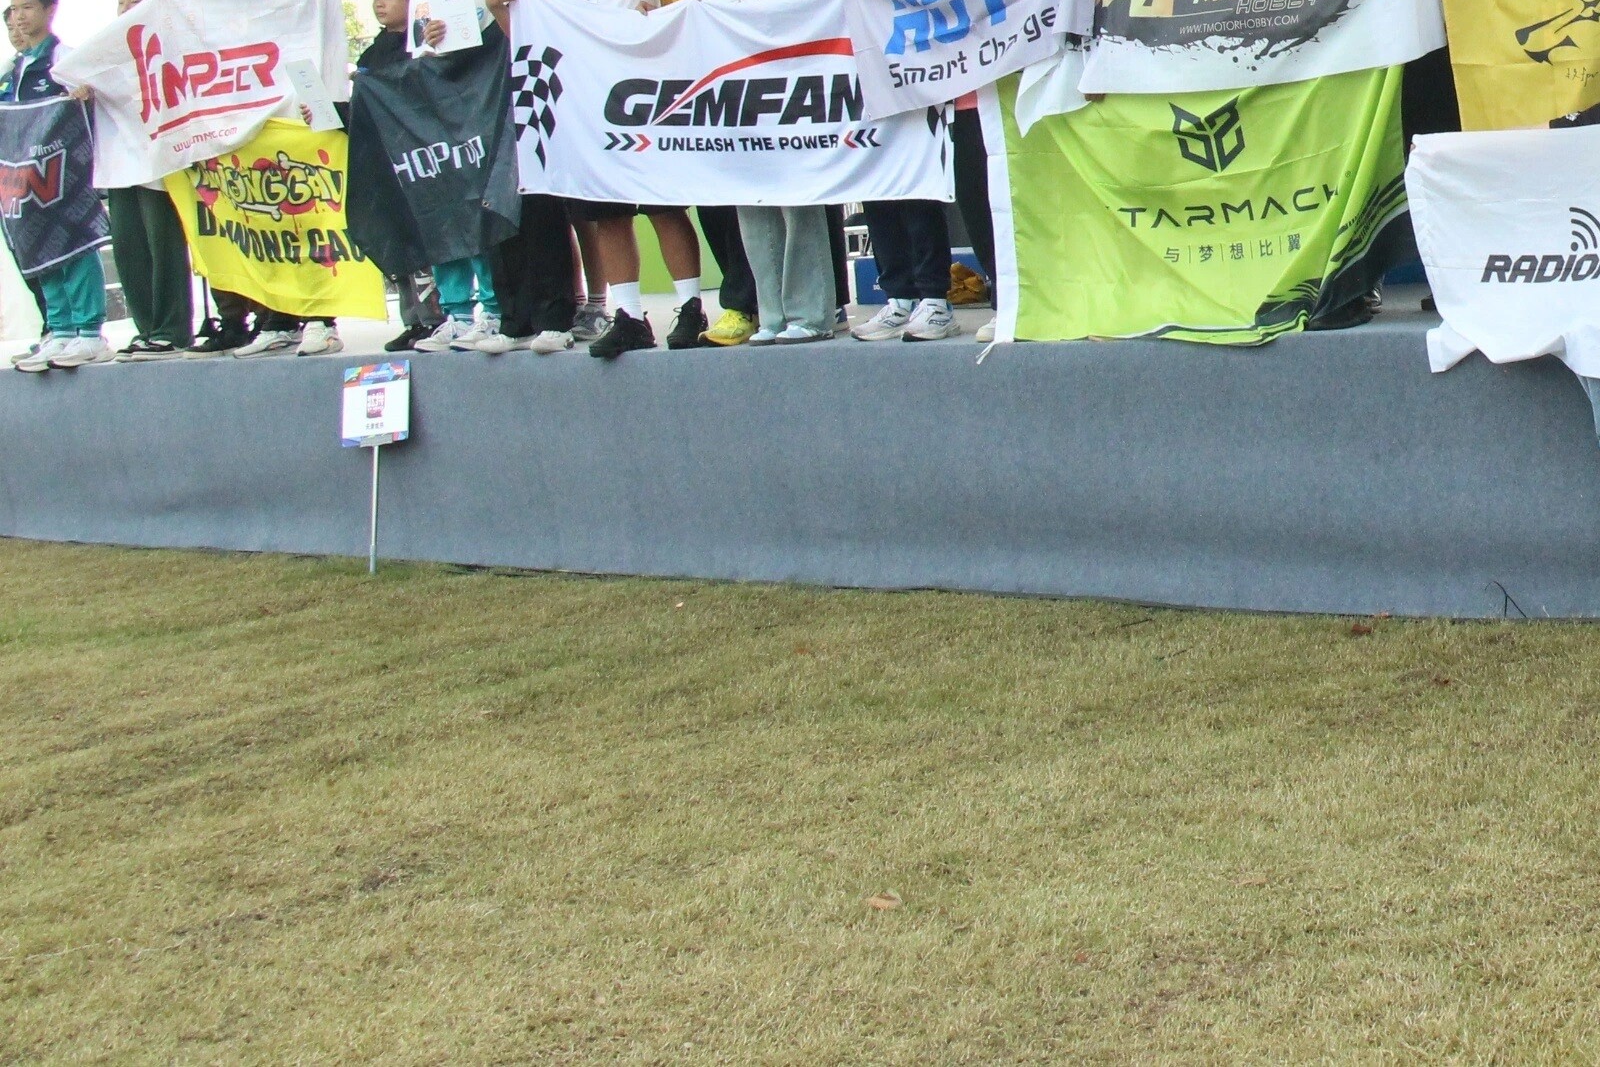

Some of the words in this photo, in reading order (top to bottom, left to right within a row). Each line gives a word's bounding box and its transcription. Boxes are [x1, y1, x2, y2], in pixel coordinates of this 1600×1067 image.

[888, 51, 968, 88] Smart
[604, 72, 864, 127] GEMFAN
[658, 136, 735, 152] UNLEASH
[739, 137, 775, 151] THE
[779, 134, 839, 151] POWER
